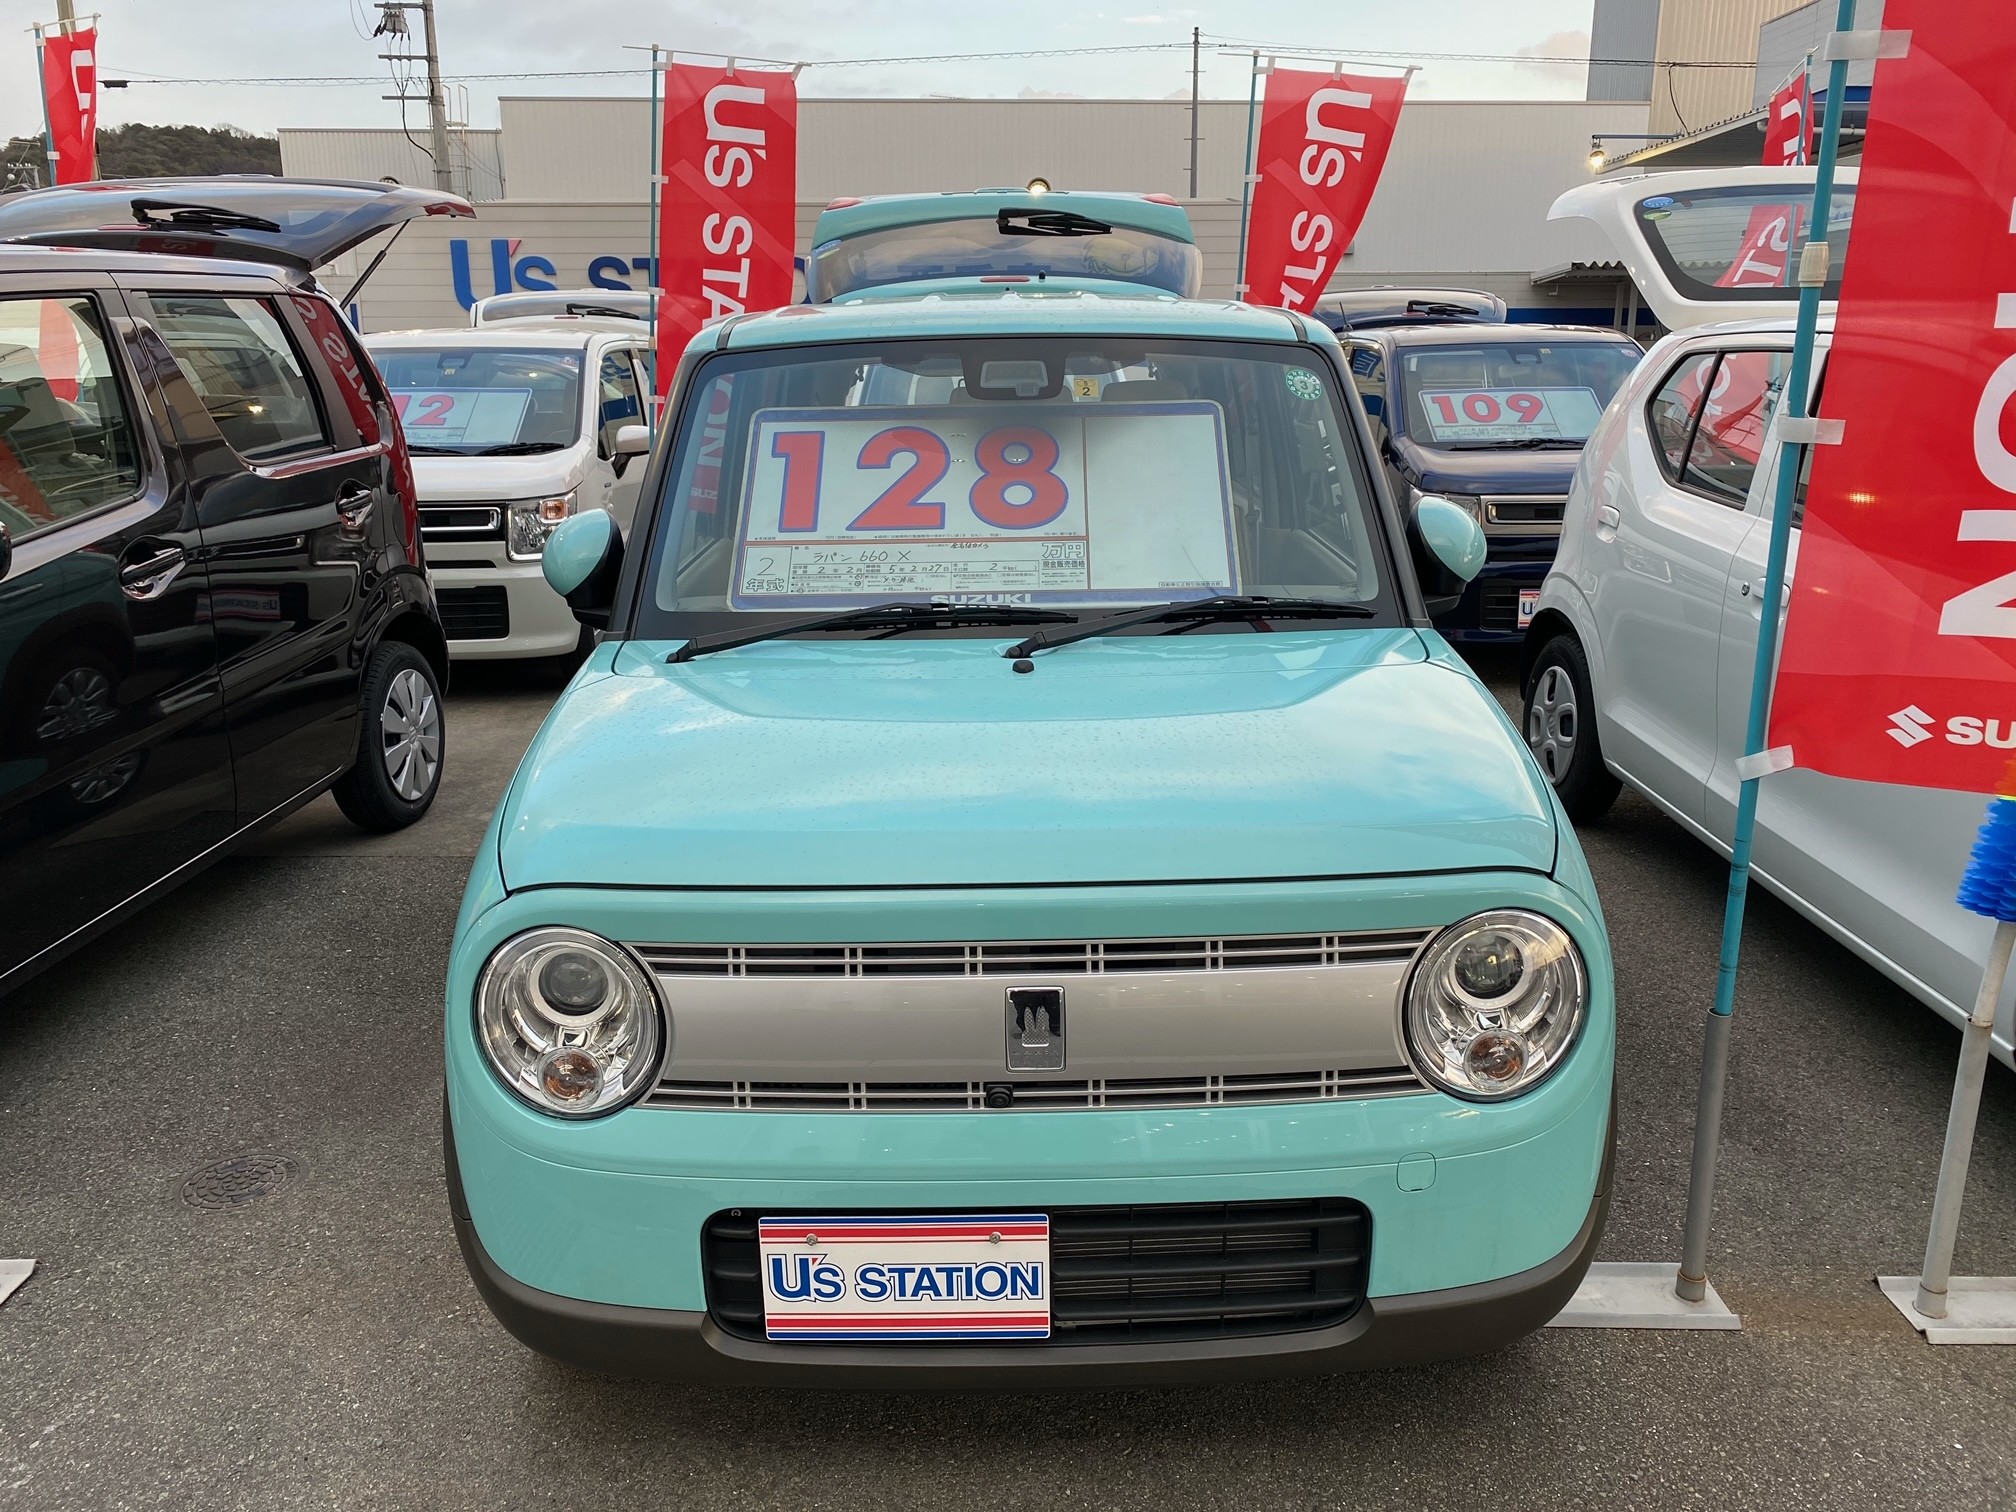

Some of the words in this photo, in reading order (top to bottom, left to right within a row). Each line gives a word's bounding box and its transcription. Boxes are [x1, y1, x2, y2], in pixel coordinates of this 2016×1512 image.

[704, 84, 767, 188] U'S
[1300, 88, 1373, 187] U'S
[1082, 387, 1091, 396] 2
[1299, 381, 1309, 390] 3
[1430, 394, 1543, 424] 109
[771, 426, 1069, 532] 128
[813, 551, 853, 563] ラパン
[859, 550, 889, 561] 660
[1041, 542, 1086, 558] 万円
[757, 557, 776, 576] 2
[1042, 560, 1085, 568] 現金販売価格
[746, 578, 785, 592] 年式
[930, 593, 1031, 604] SUZUKI
[768, 1255, 845, 1301] U'S
[856, 1263, 1043, 1301] STATION
